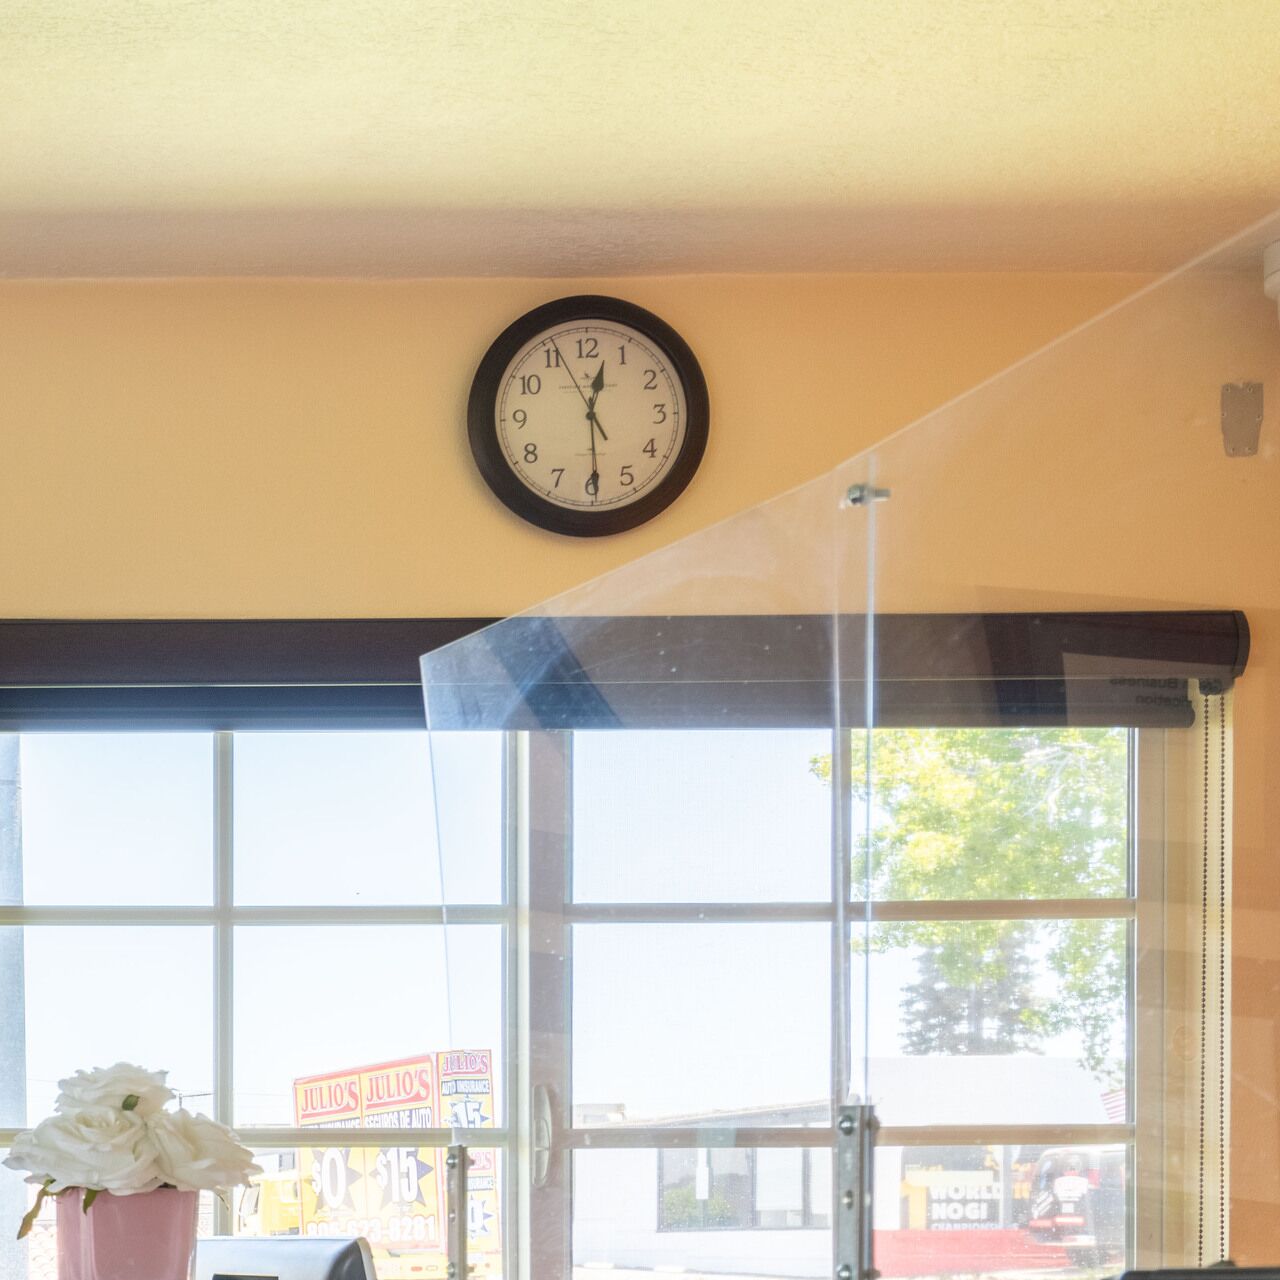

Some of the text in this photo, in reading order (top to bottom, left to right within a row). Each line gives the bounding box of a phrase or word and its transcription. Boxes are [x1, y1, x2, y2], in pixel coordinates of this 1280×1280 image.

[544, 348, 560, 368] 11
[576, 338, 599, 358] 12
[618, 345, 627, 364] 1
[520, 375, 541, 395] 10
[644, 370, 658, 390] 2
[513, 409, 527, 429] 9
[653, 404, 666, 424] 3
[524, 443, 538, 463] 8
[643, 439, 657, 458] 4
[551, 469, 565, 488] 7
[620, 465, 634, 486] 5
[585, 478, 599, 495] 6
[443, 1055, 488, 1073] JULIO'S
[367, 1070, 430, 1102] JULIO'S
[302, 1081, 358, 1112] JULIO'S
[400, 1110, 411, 1128] DE
[412, 1107, 432, 1128] AUTO
[932, 1202, 988, 1220] NOGI
